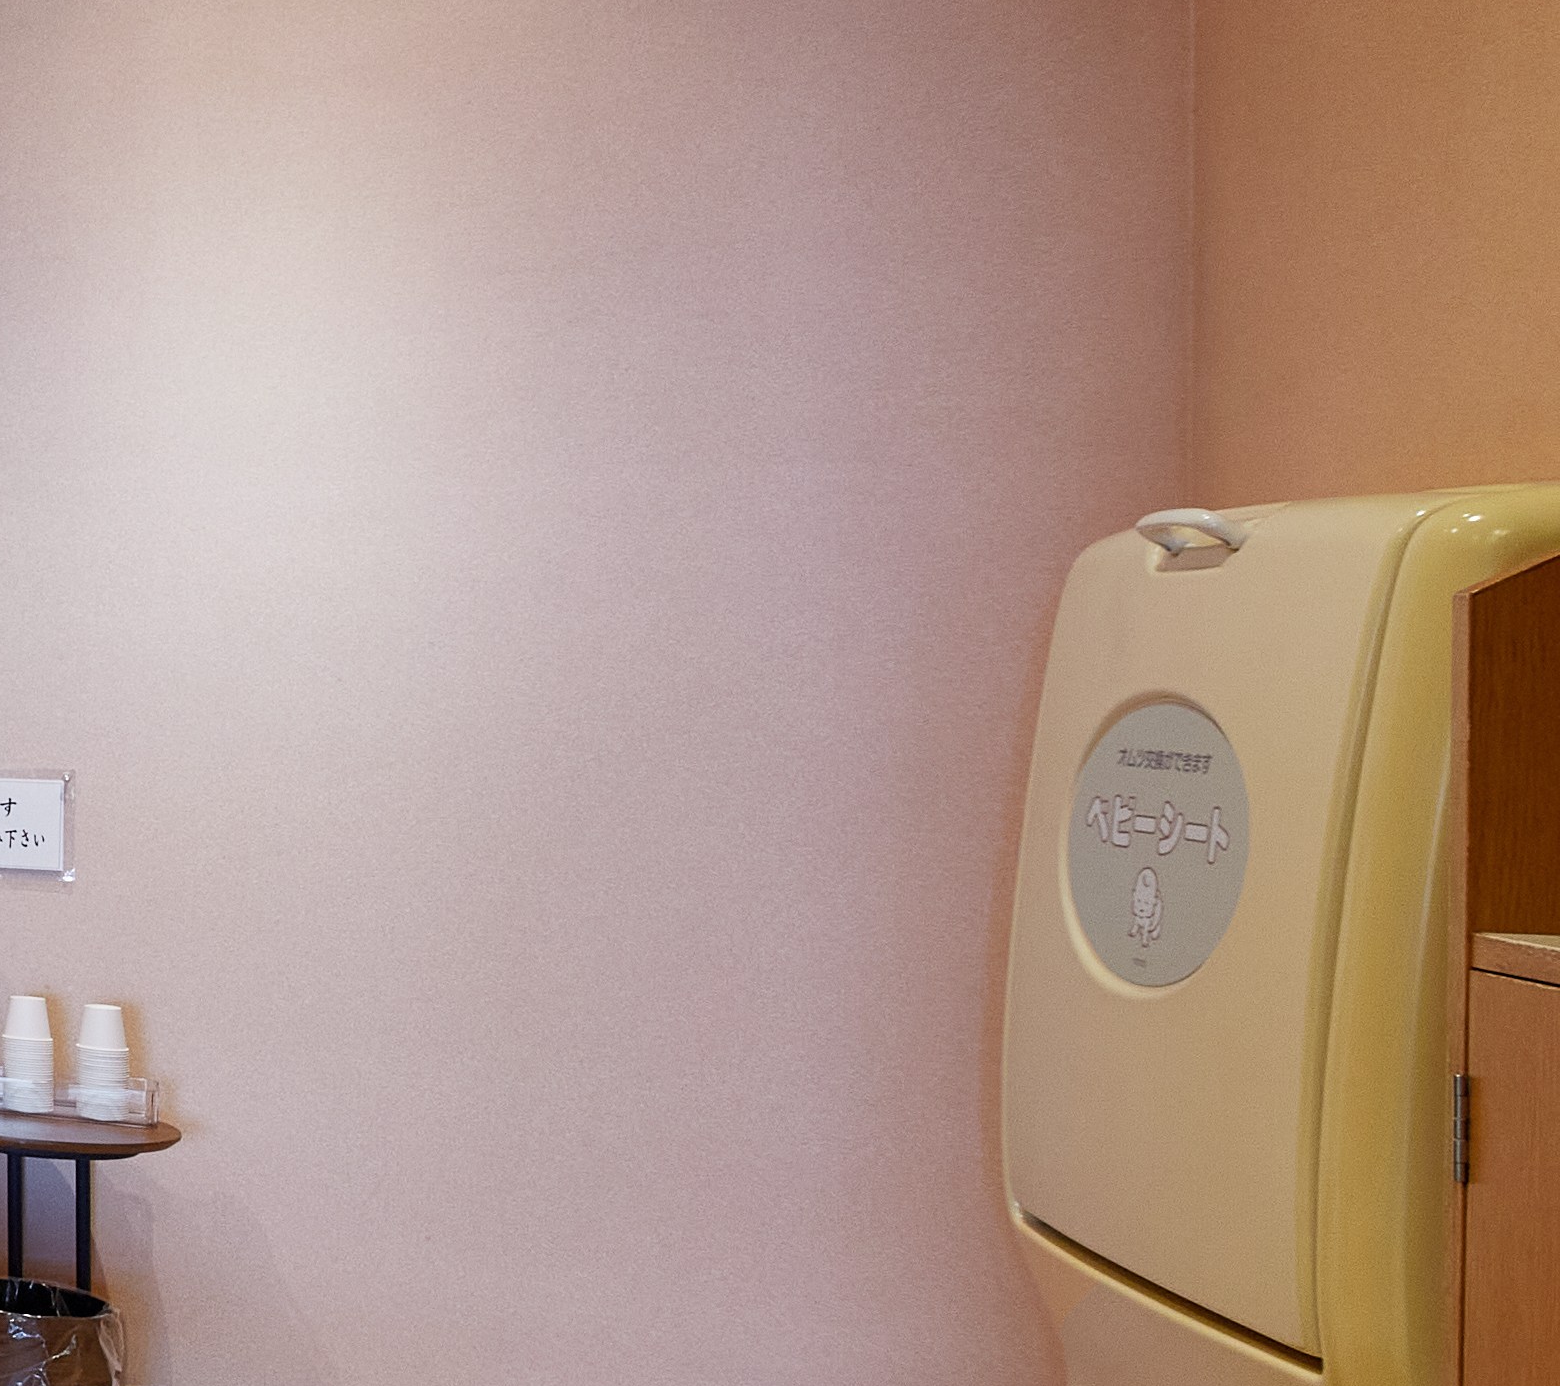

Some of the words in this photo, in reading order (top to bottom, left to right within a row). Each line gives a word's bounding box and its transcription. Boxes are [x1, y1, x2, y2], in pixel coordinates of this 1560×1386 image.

[1086, 794, 1230, 865] ベビーシート
